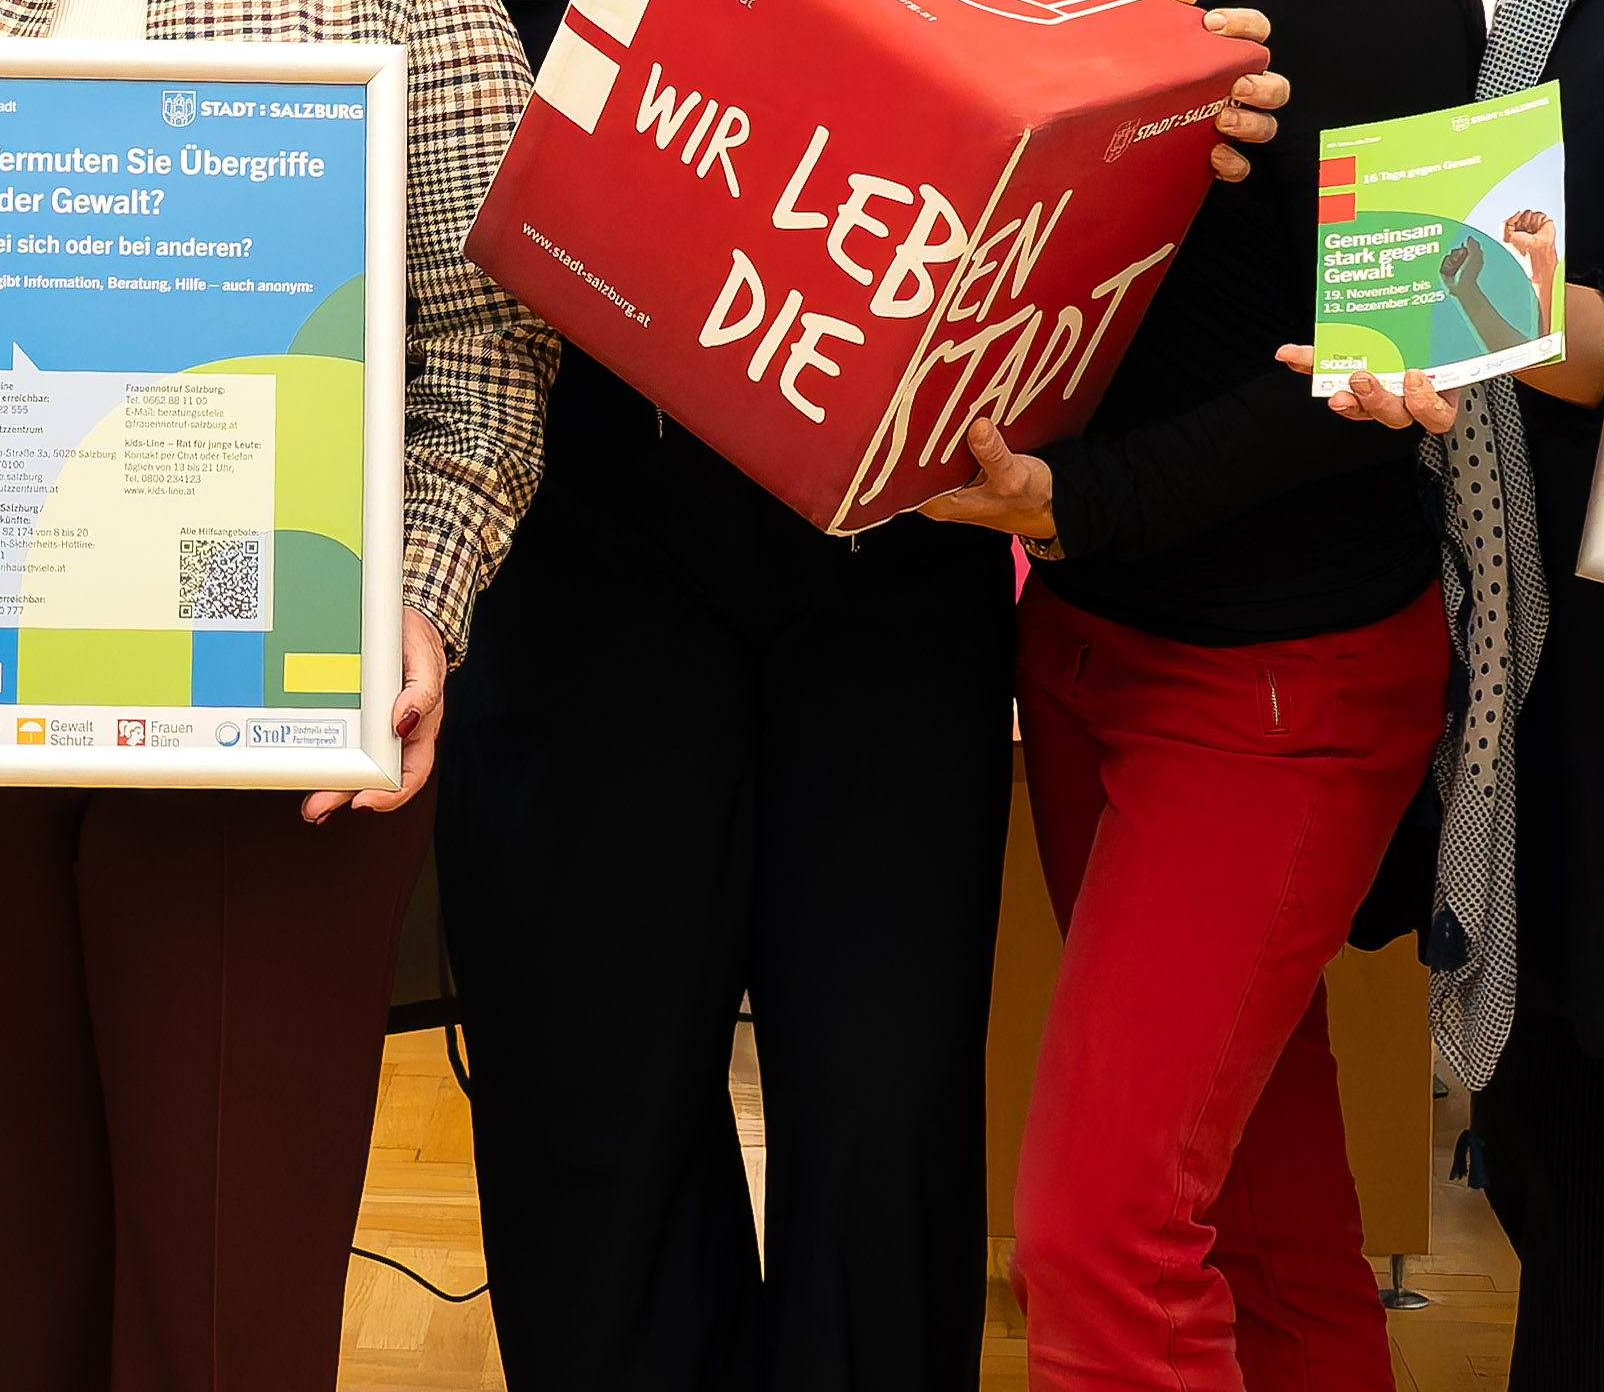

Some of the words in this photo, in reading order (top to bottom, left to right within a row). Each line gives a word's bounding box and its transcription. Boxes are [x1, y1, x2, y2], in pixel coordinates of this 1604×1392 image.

[200, 102, 256, 117] STADT
[269, 103, 364, 120] SALZBURG
[1133, 114, 1179, 143] STADT
[127, 147, 171, 176] Sie
[180, 144, 326, 182] Übergriffe
[1364, 174, 1378, 184] 16
[1381, 170, 1406, 182] Tage
[1408, 163, 1442, 179] gegen
[1443, 154, 1482, 170] Gewalt
[51, 188, 165, 216] Gewalt?
[635, 62, 751, 198] WIR
[772, 125, 1074, 323] LEBEN
[17, 235, 60, 255] sich
[65, 236, 113, 256] oder
[118, 236, 151, 256] bei
[155, 237, 253, 258] anderen?
[1324, 223, 1443, 249] Gemeinsam
[1324, 248, 1376, 267] stark
[1378, 241, 1440, 265] gegen
[522, 222, 651, 328] www.stadt-salzburg.at
[1324, 263, 1395, 284] Gewalt
[23, 275, 104, 292] Information,
[107, 276, 171, 294] Beratung,
[175, 277, 206, 292] Hilfe
[222, 278, 255, 293] auch
[257, 280, 314, 296] anonym:
[1324, 290, 1344, 301] 19.
[1346, 284, 1411, 299] November
[1412, 280, 1432, 292] bis
[1323, 303, 1345, 314] 13.
[1346, 298, 1411, 313] Dezember
[1411, 290, 1446, 306] 2025
[698, 248, 865, 424] DIE
[859, 243, 1175, 505] STADT
[1320, 356, 1368, 370] sozial
[50, 720, 93, 732] Gewalt
[152, 721, 192, 734] Frauen
[50, 735, 93, 746] Schutz
[152, 735, 179, 747] Büro
